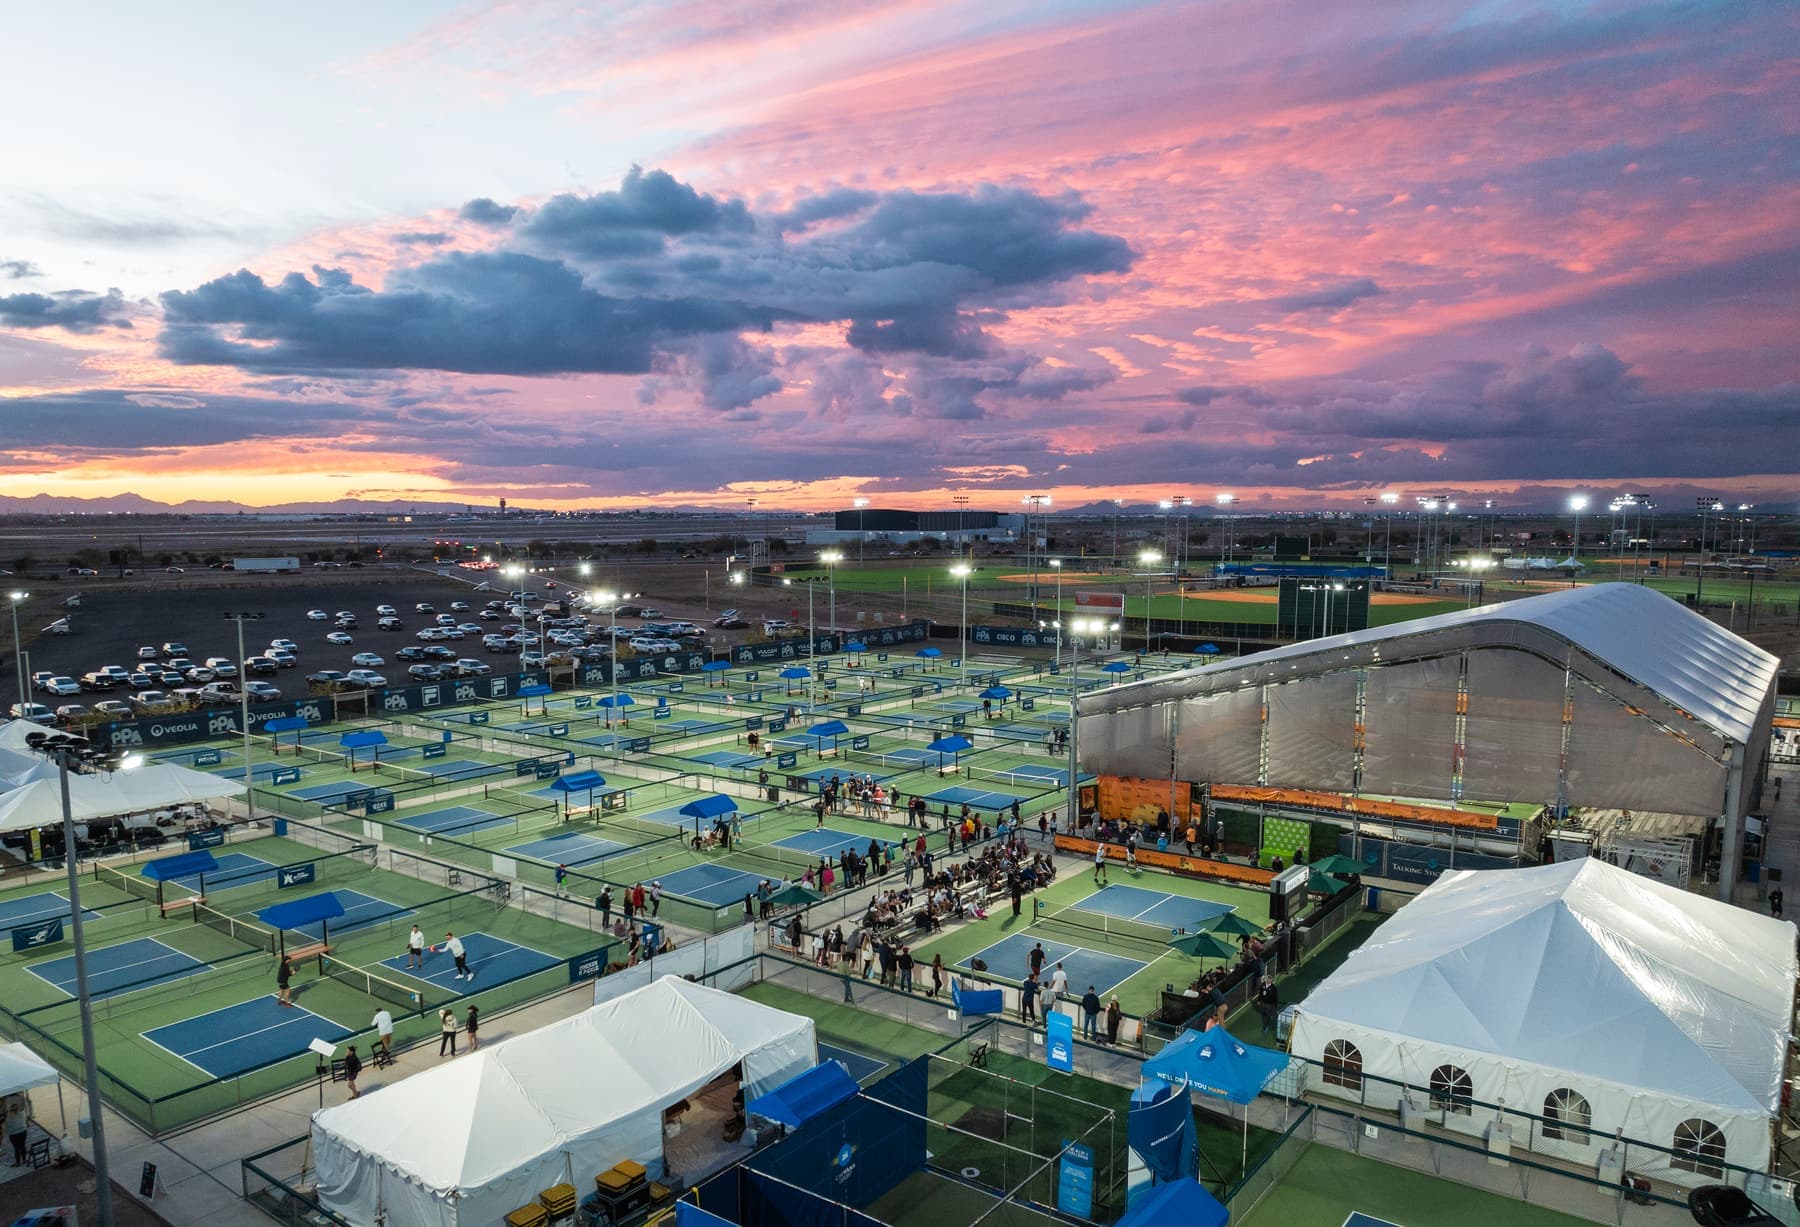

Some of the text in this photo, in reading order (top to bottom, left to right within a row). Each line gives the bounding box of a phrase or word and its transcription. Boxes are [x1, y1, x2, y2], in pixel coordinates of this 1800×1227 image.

[586, 669, 603, 682] PPA
[640, 662, 655, 675] PPA
[456, 685, 476, 699] PPA
[385, 695, 408, 709] PPA
[256, 712, 286, 721] VEOLIA
[296, 705, 321, 721] PPA
[165, 723, 198, 733] VEOLIA
[209, 715, 237, 733] PPA
[111, 728, 143, 744] PPA
[1392, 863, 1422, 874] TALKING
[1157, 1072, 1174, 1081] WE'LL
[1194, 1081, 1207, 1090] YOU
